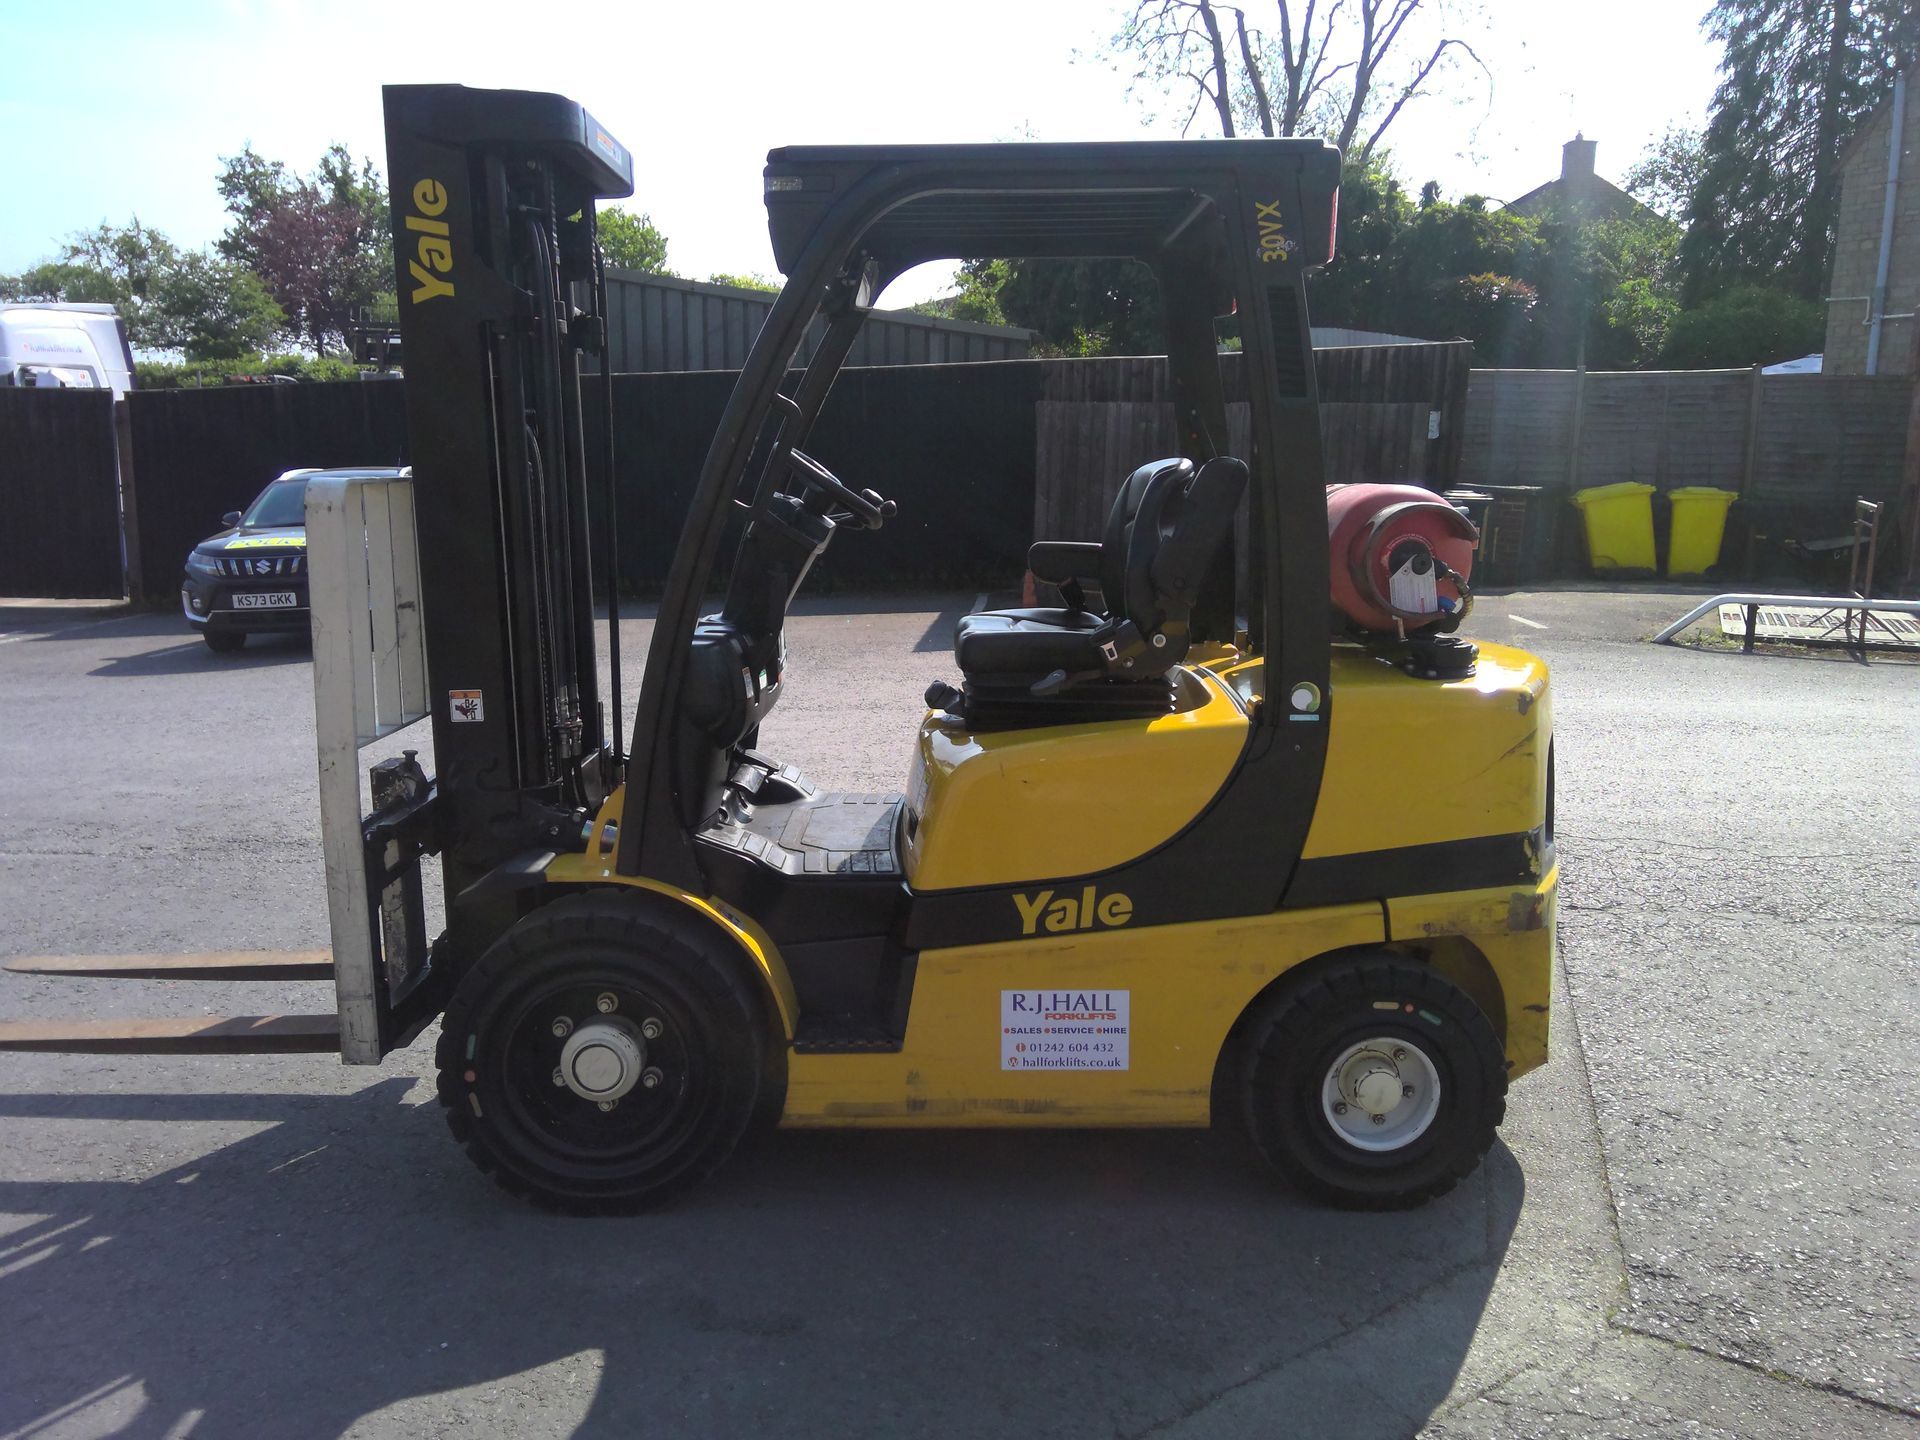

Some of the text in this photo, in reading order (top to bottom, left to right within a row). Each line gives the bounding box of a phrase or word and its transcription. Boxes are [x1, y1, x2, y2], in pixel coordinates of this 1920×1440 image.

[1255, 199, 1288, 263] 30VX
[405, 178, 455, 304] Yale
[237, 593, 293, 607] KS73 GKK
[1012, 886, 1133, 934] Yale
[1045, 1012, 1117, 1021] FORKLIFTS
[1010, 1027, 1127, 1035] SALES SERVICE HIRE
[1029, 1042, 1065, 1052] 01242
[1068, 1042, 1089, 1052] 604
[1092, 1042, 1114, 1052] 432
[1022, 1056, 1121, 1067] hallforklifts.co.uk
